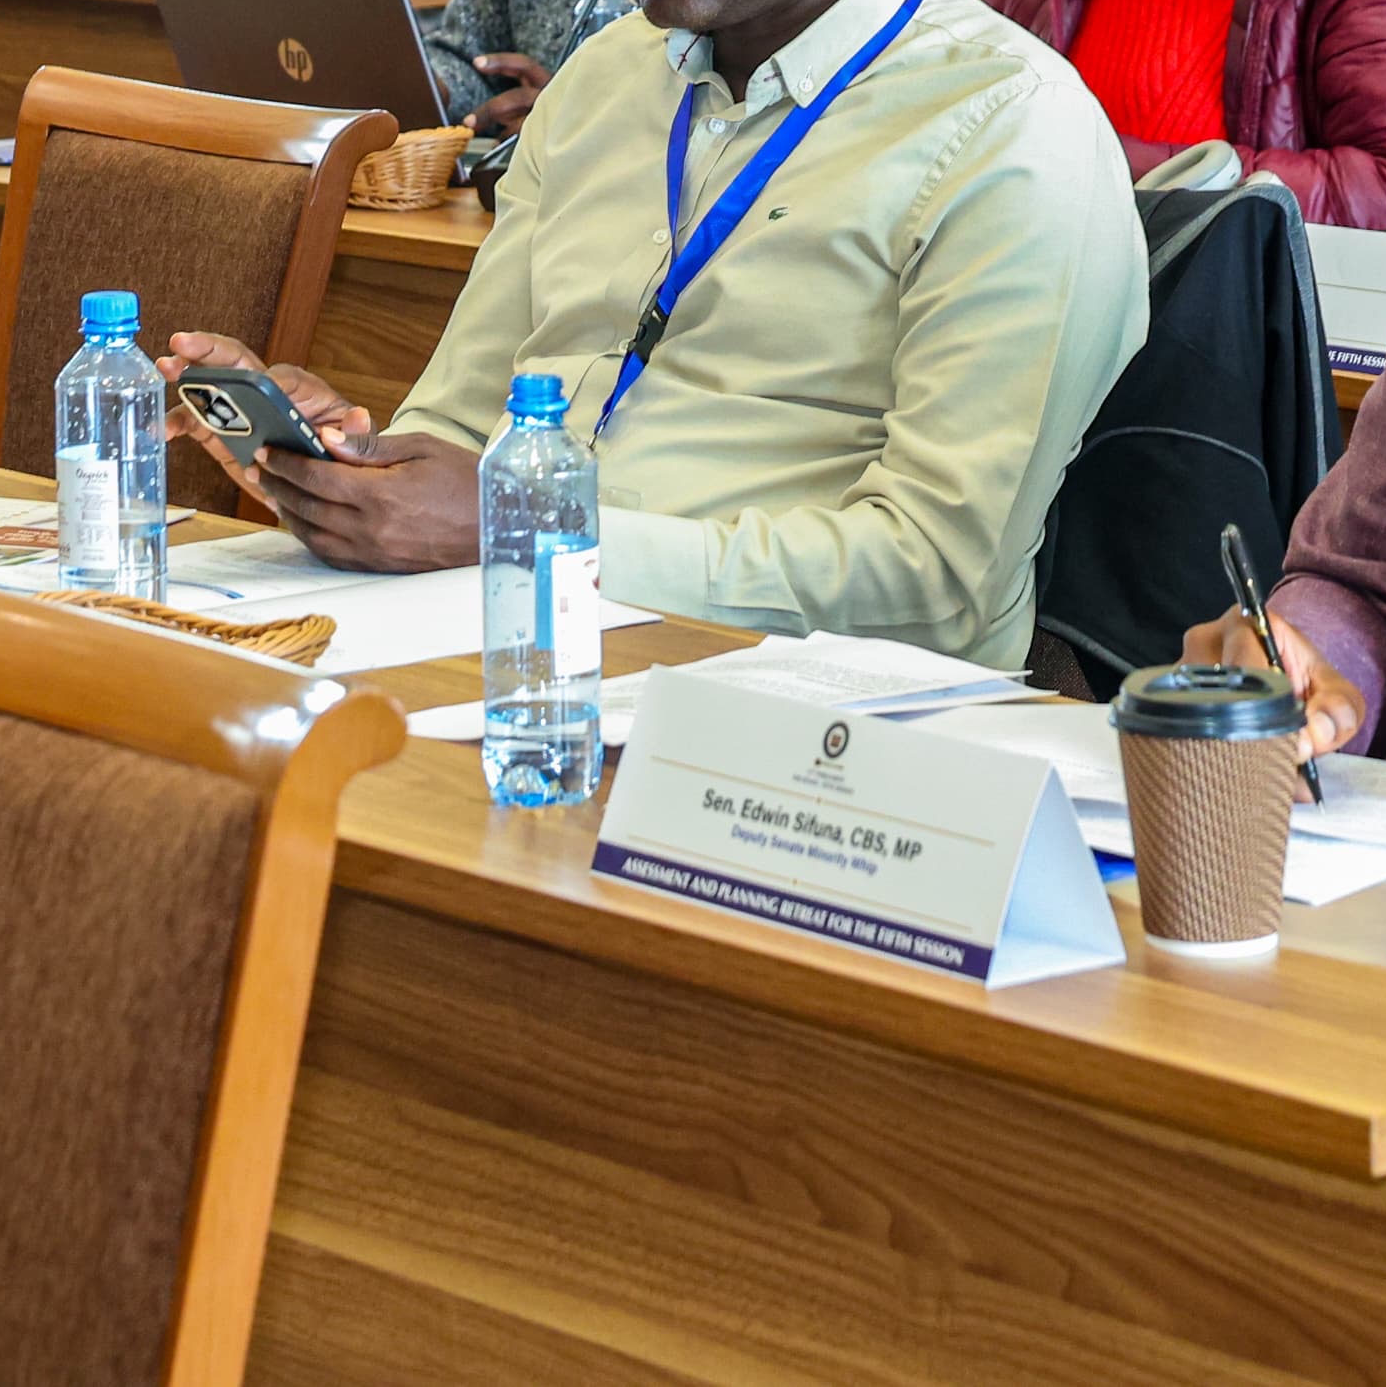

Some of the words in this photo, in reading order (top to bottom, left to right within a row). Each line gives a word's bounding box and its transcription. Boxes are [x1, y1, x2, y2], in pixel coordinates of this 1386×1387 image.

[282, 38, 309, 81] hp
[1336, 351, 1362, 365] FIFTH
[1362, 354, 1386, 368] SESSI
[702, 788, 736, 815] Sen.
[740, 797, 790, 828] Edwin
[792, 811, 844, 846] Sifuna,
[850, 826, 888, 857] CBS,
[893, 837, 922, 862] MP
[731, 823, 767, 847] Deputy
[771, 835, 805, 855] Senate
[808, 844, 848, 868] Minority
[851, 856, 878, 875] Whip
[621, 856, 692, 889] ASSESSMENT
[690, 875, 718, 897] AND
[716, 882, 780, 914] PLANNING
[779, 899, 828, 928] RETREAT
[826, 912, 854, 936] FOR
[853, 919, 878, 943] THE
[877, 925, 913, 952] FIFTH
[913, 936, 965, 967] SESSION
